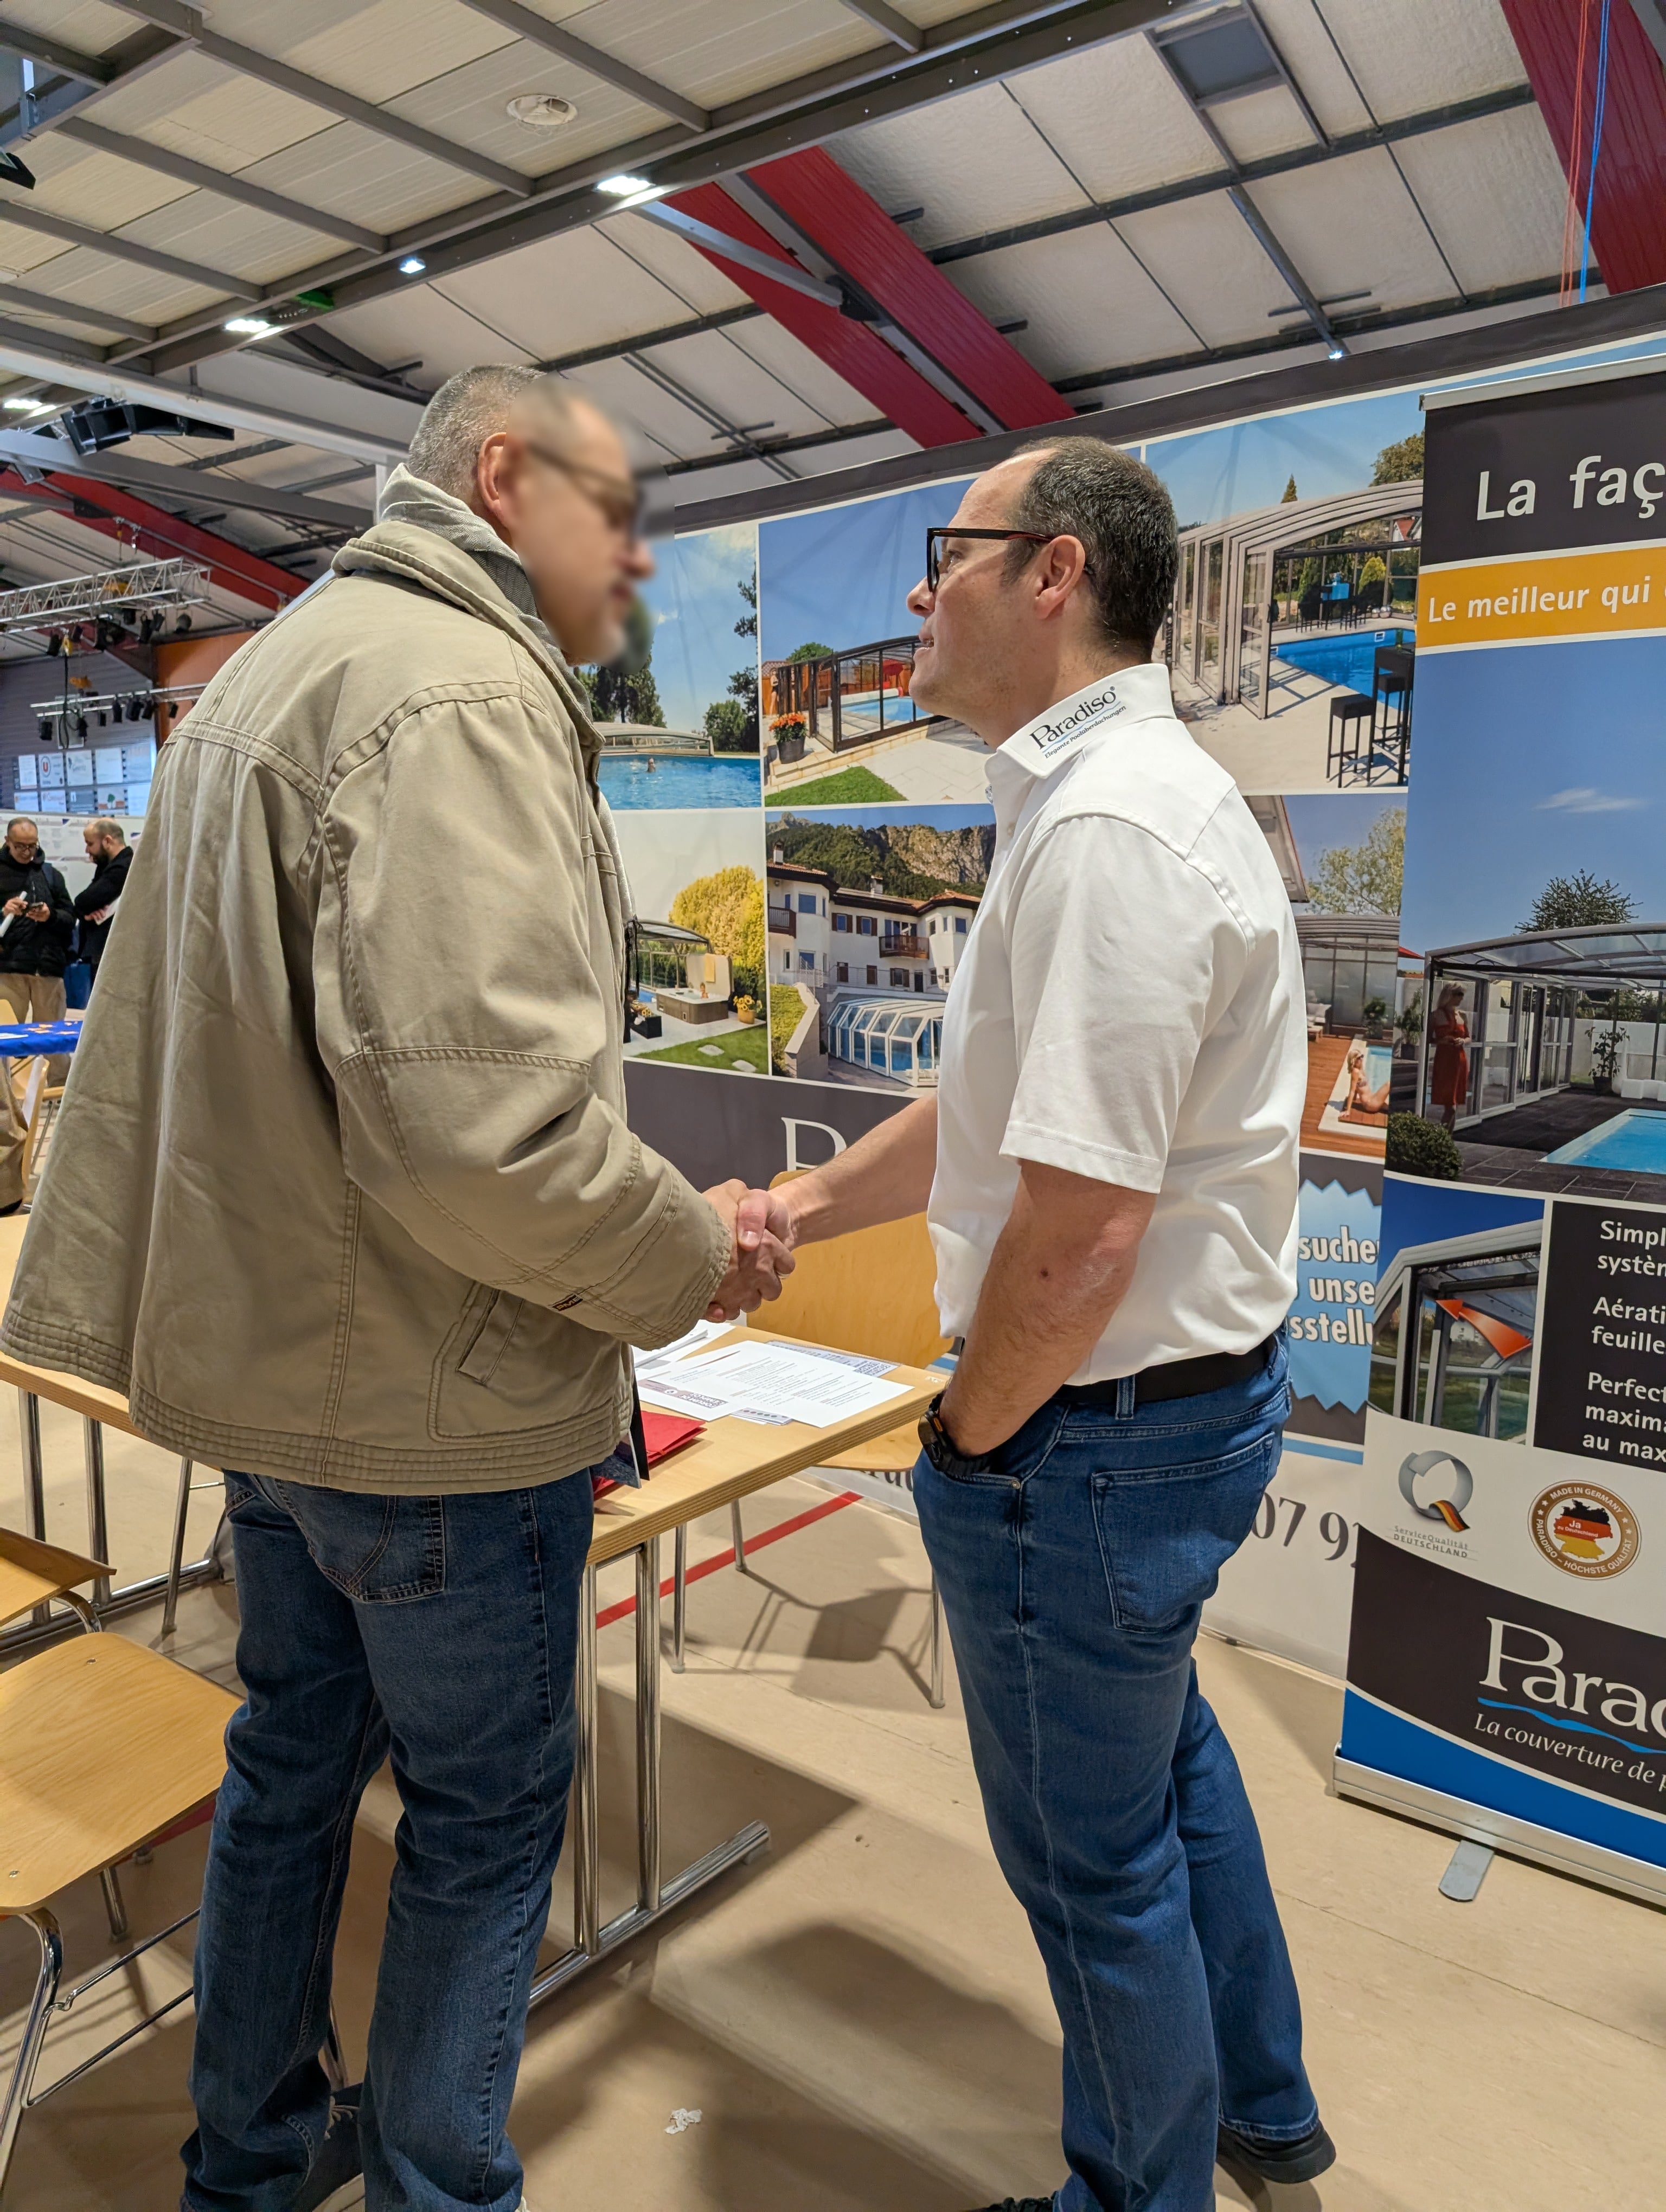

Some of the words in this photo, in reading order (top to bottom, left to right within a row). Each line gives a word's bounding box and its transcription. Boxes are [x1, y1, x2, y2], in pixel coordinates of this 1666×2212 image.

[1477, 471, 1536, 520] La
[1428, 597, 1456, 623] Le
[1468, 586, 1590, 618] meilleur
[1601, 576, 1651, 613] qui
[1045, 741, 1070, 759] Elegante
[1600, 1220, 1666, 1250] Simpl
[1592, 1296, 1666, 1324] Aérati
[1582, 1433, 1610, 1451] au
[1549, 1487, 1573, 1500] MADE
[1585, 1488, 1624, 1514] GERMANY
[1569, 1520, 1581, 1529] Ja
[1393, 1534, 1468, 1558] DEUTSCHLAND
[1536, 1518, 1558, 1558] PARADISO
[1564, 1560, 1608, 1574] HÖCHSTE
[1475, 1713, 1500, 1736] La
[1504, 1727, 1624, 1773] couverture
[1627, 1761, 1656, 1784] de
